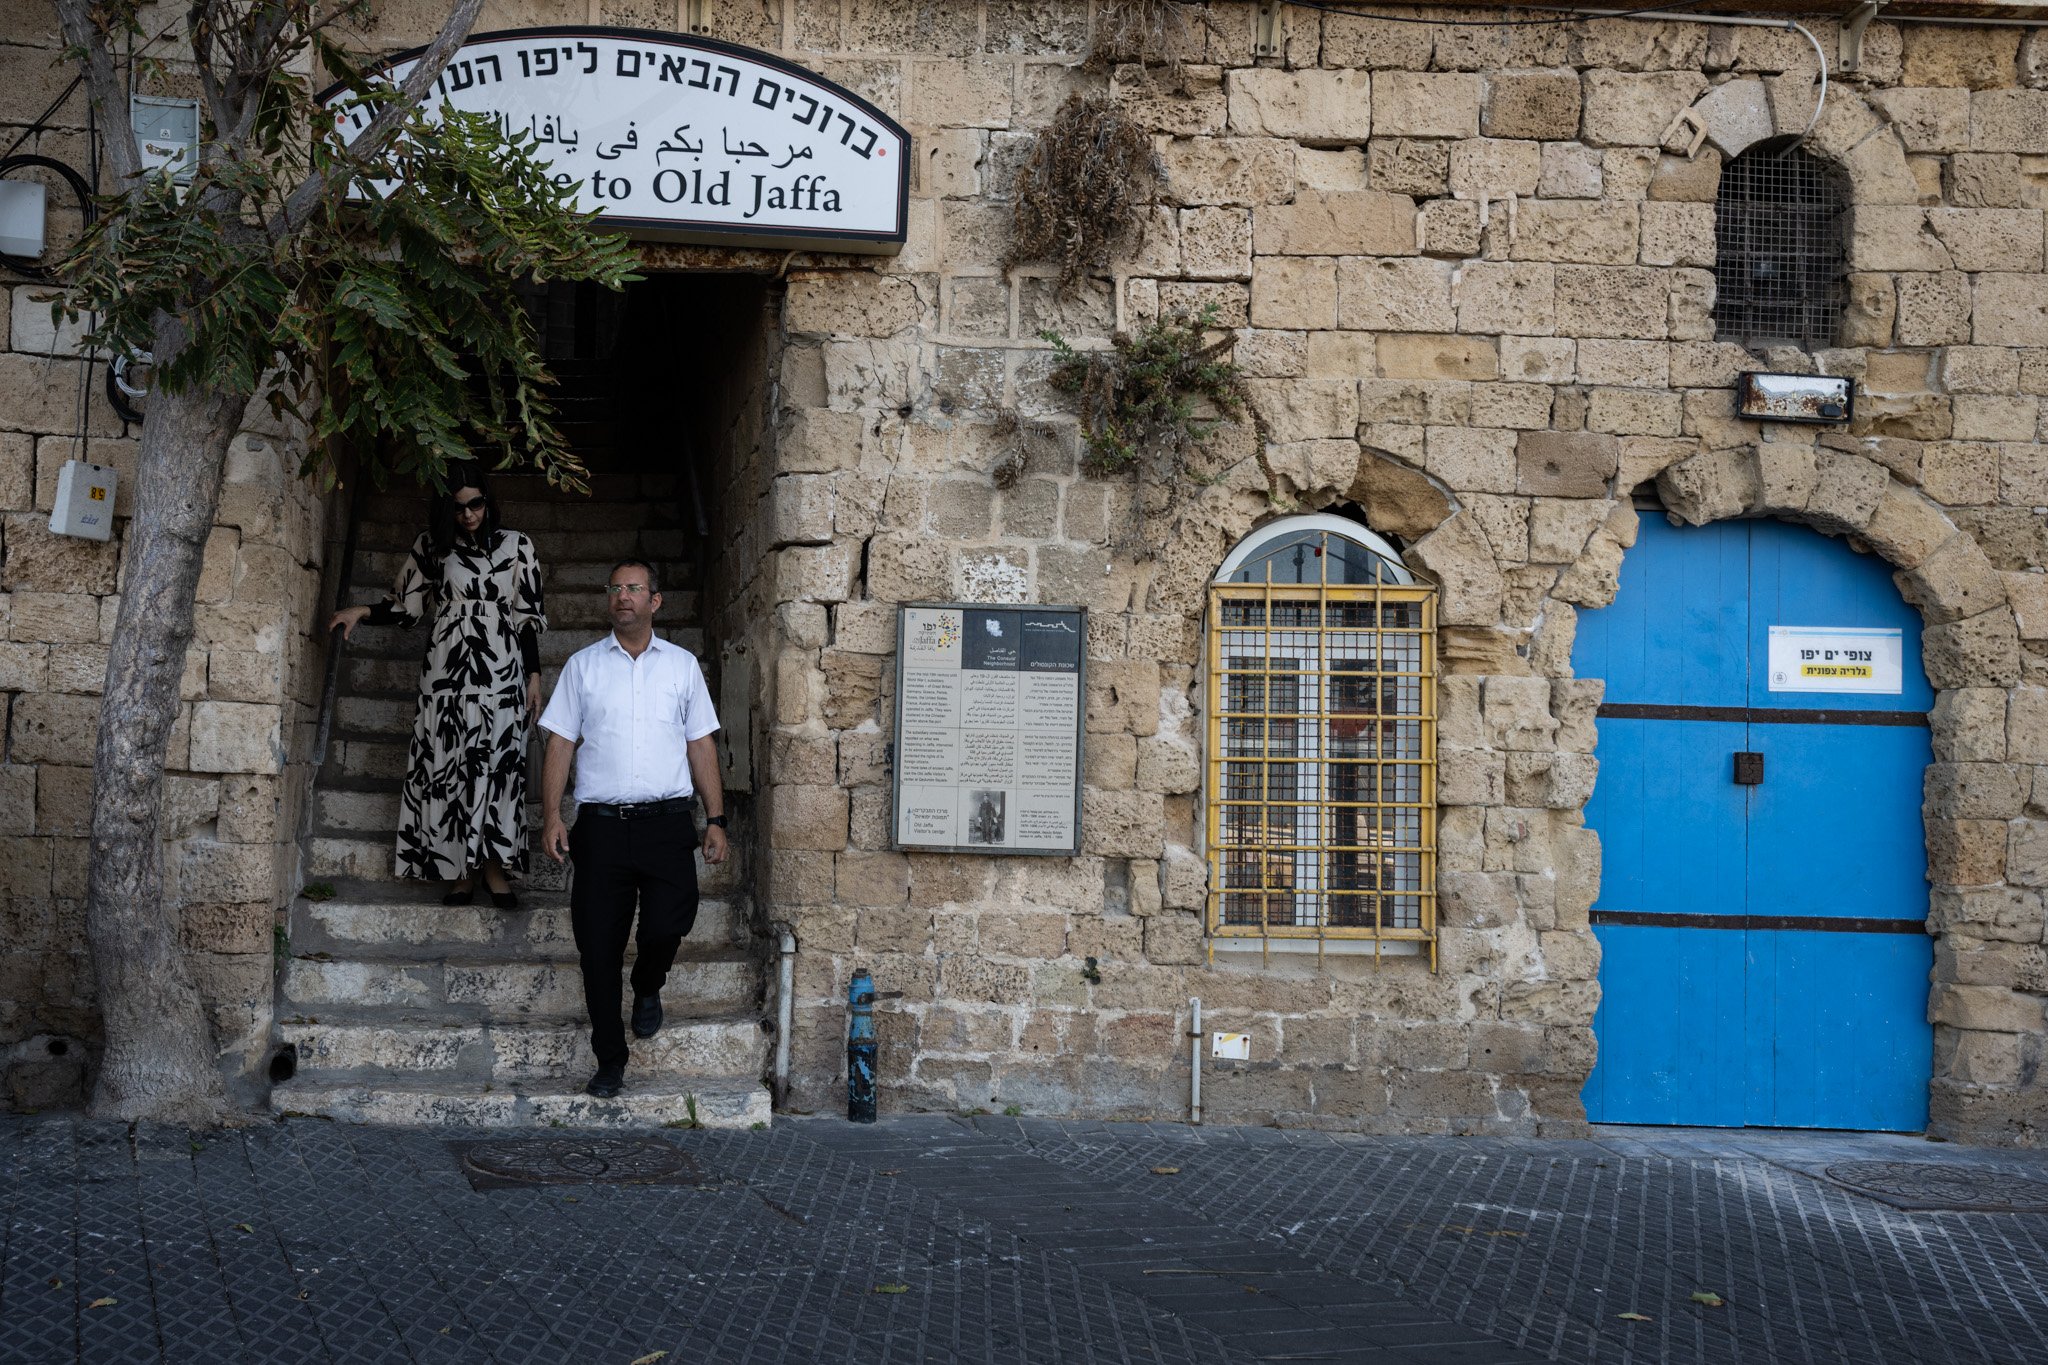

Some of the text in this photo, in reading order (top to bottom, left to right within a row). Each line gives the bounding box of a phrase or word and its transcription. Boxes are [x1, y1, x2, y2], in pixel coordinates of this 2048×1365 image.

[517, 42, 597, 77] ליפו
[616, 49, 740, 97] הבאים
[530, 114, 579, 155] يافا
[752, 77, 879, 160] ברוכים
[656, 125, 703, 167] بكم
[592, 169, 843, 219] to Old Jaffa
[1800, 649, 1872, 661] צופי ים יפו
[1806, 666, 1867, 676] גלריה צפונית
